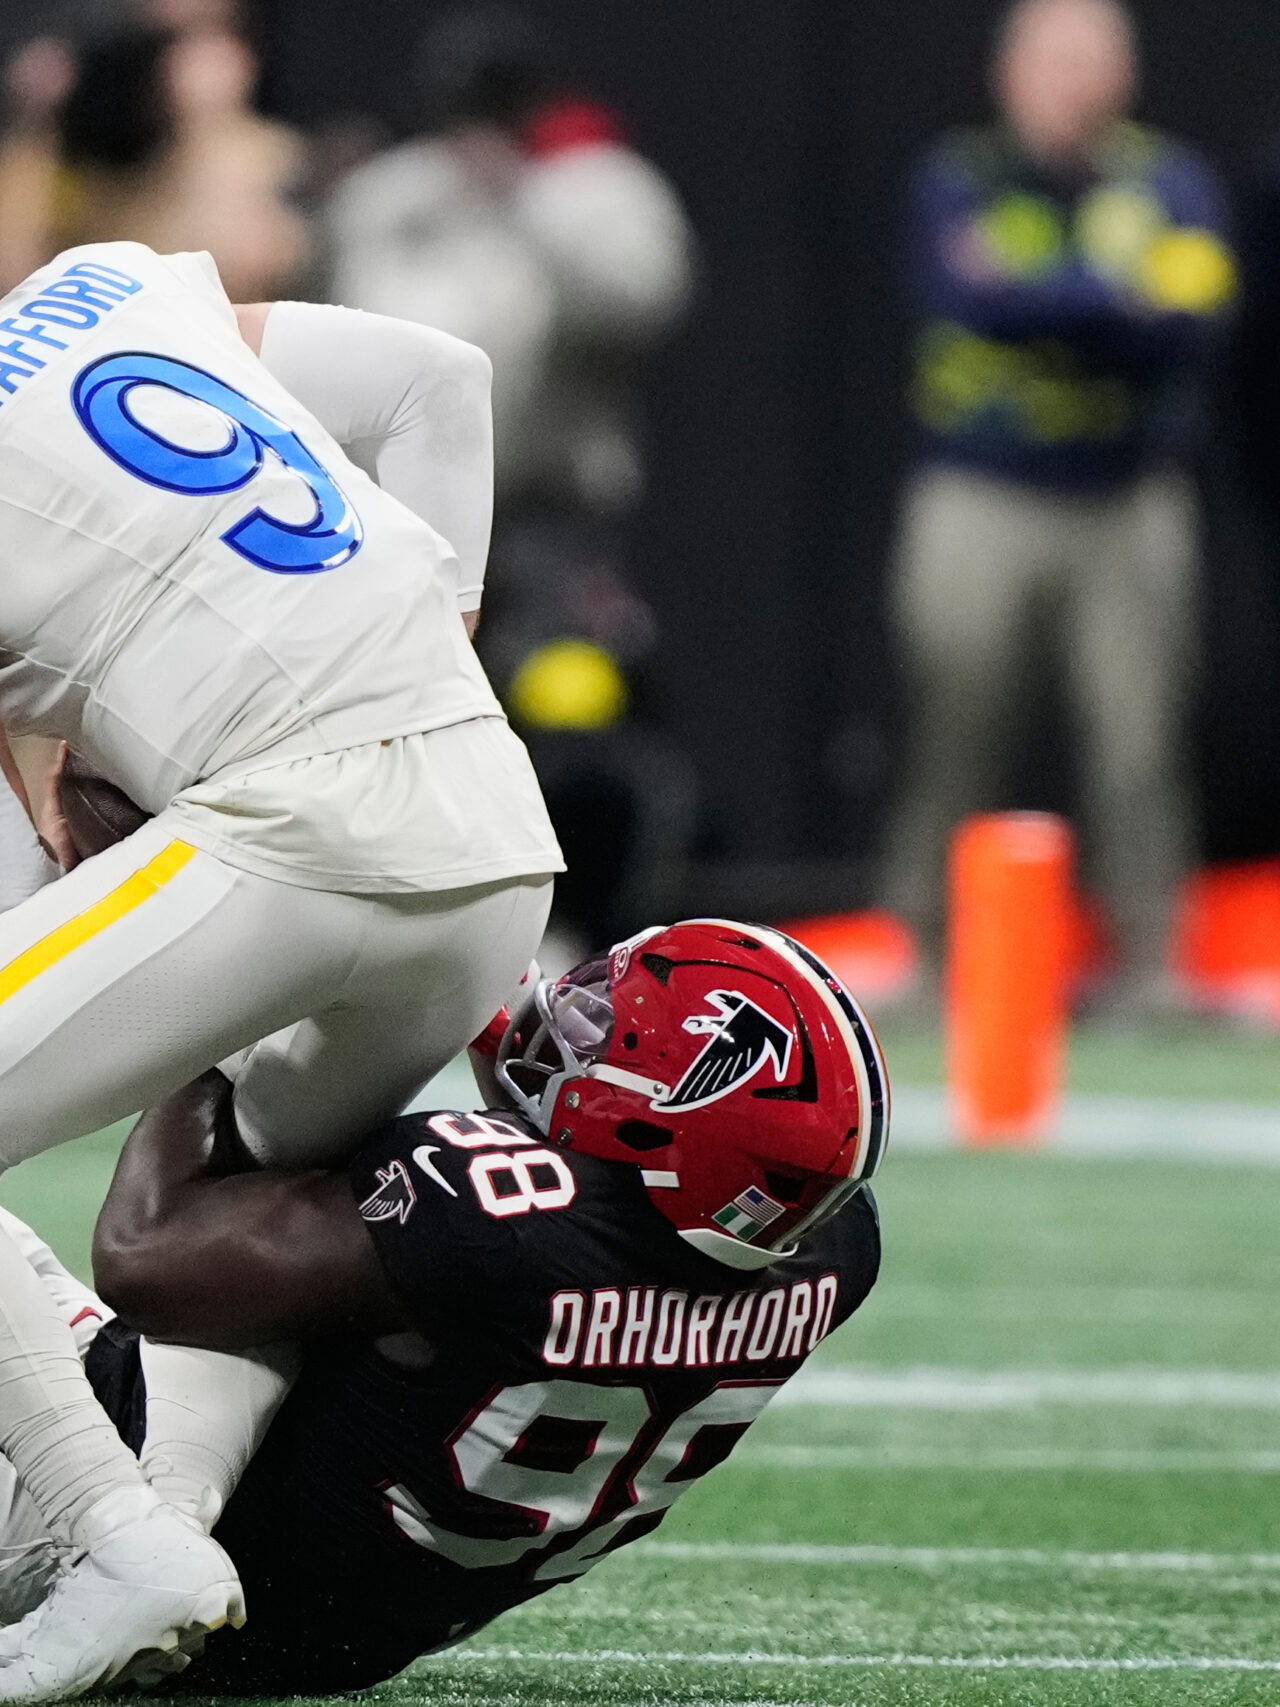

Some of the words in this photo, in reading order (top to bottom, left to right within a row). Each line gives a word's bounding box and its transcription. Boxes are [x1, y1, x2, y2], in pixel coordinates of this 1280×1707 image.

[69, 349, 365, 575] 9
[426, 1112, 578, 1219] 98
[541, 1271, 839, 1367] ORHORHORO
